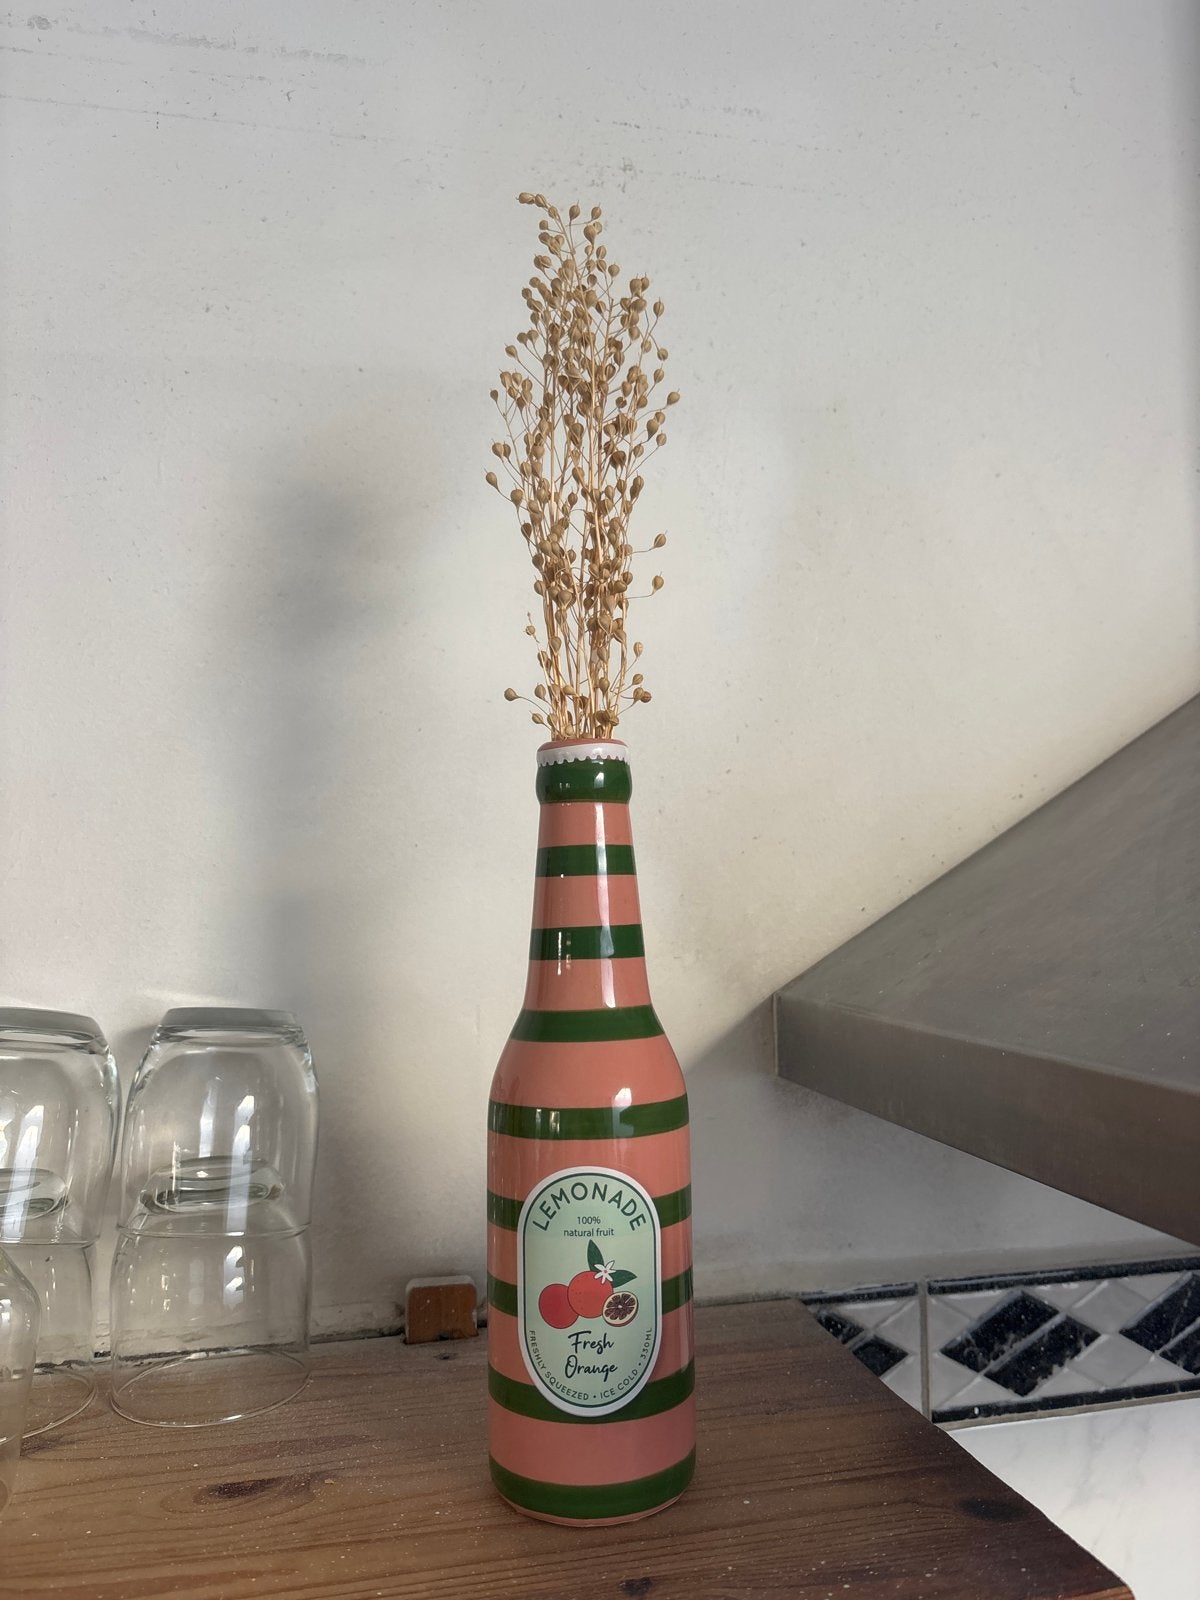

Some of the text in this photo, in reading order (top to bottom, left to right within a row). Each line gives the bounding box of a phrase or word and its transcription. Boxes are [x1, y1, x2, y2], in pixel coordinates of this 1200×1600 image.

[532, 1182, 647, 1231] LEMONADE
[563, 1228, 615, 1237] natural fruit
[577, 1216, 601, 1225] 100%
[568, 1330, 614, 1354] Fresh
[529, 1327, 653, 1400] FRESHLY SQUEEZED ICE COLD 330ML
[565, 1355, 618, 1382] Orange
